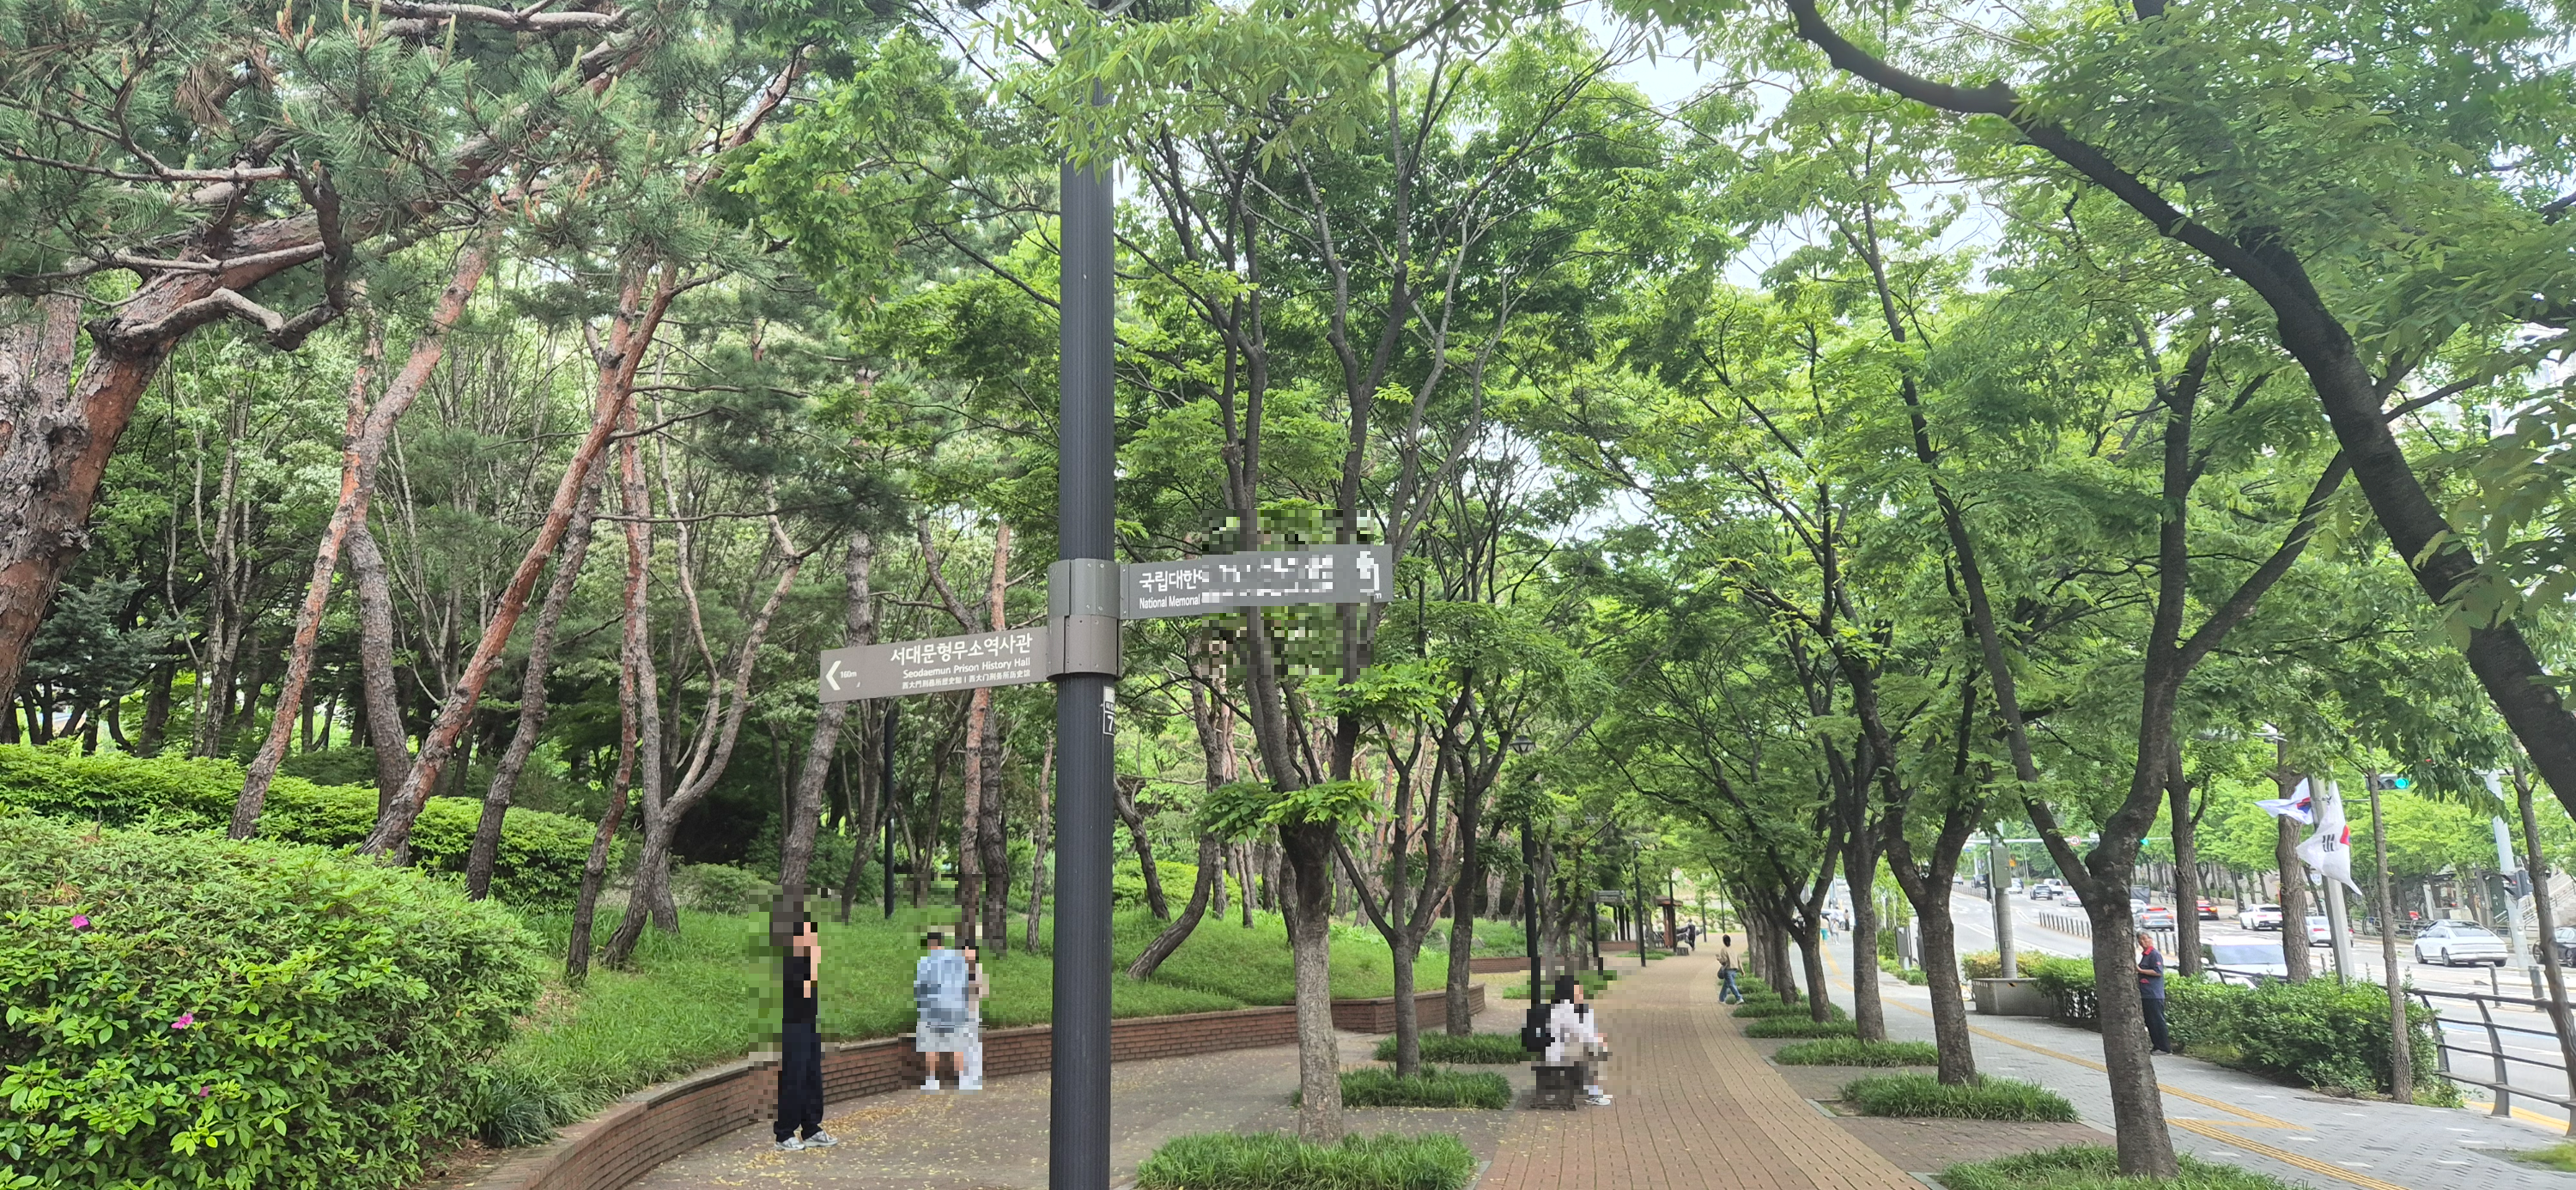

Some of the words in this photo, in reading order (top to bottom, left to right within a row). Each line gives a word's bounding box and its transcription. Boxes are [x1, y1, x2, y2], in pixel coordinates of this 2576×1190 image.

[1139, 597, 1168, 609] National
[1169, 593, 1200, 607] Memorial
[890, 633, 1033, 665] 서대문형무소역사관
[903, 667, 951, 678] Seodaemun
[953, 664, 980, 674] Prison
[981, 659, 1012, 671] History
[1014, 657, 1030, 668] Hall
